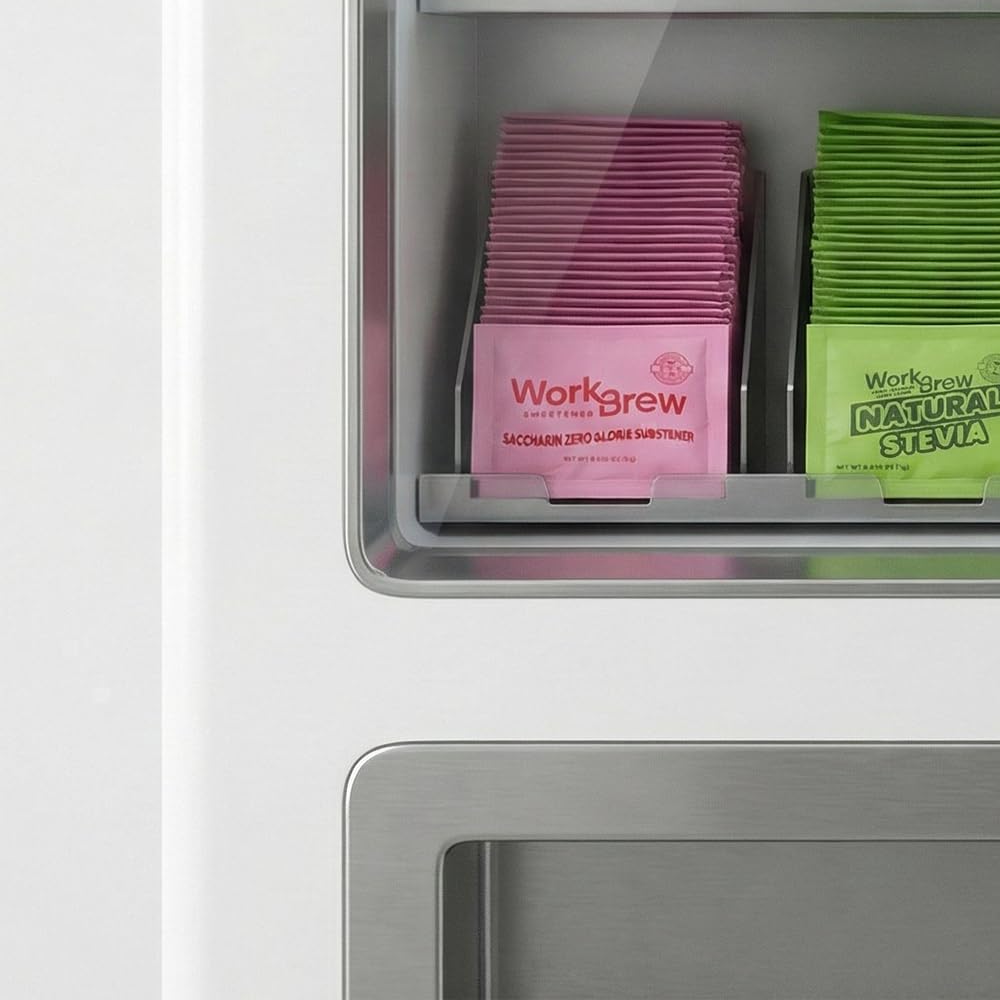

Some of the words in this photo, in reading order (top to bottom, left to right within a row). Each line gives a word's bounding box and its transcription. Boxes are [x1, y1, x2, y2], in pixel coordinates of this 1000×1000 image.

[510, 376, 688, 418] WorkBrew
[564, 431, 593, 445] ZERO
[880, 419, 990, 458] STEVIA
